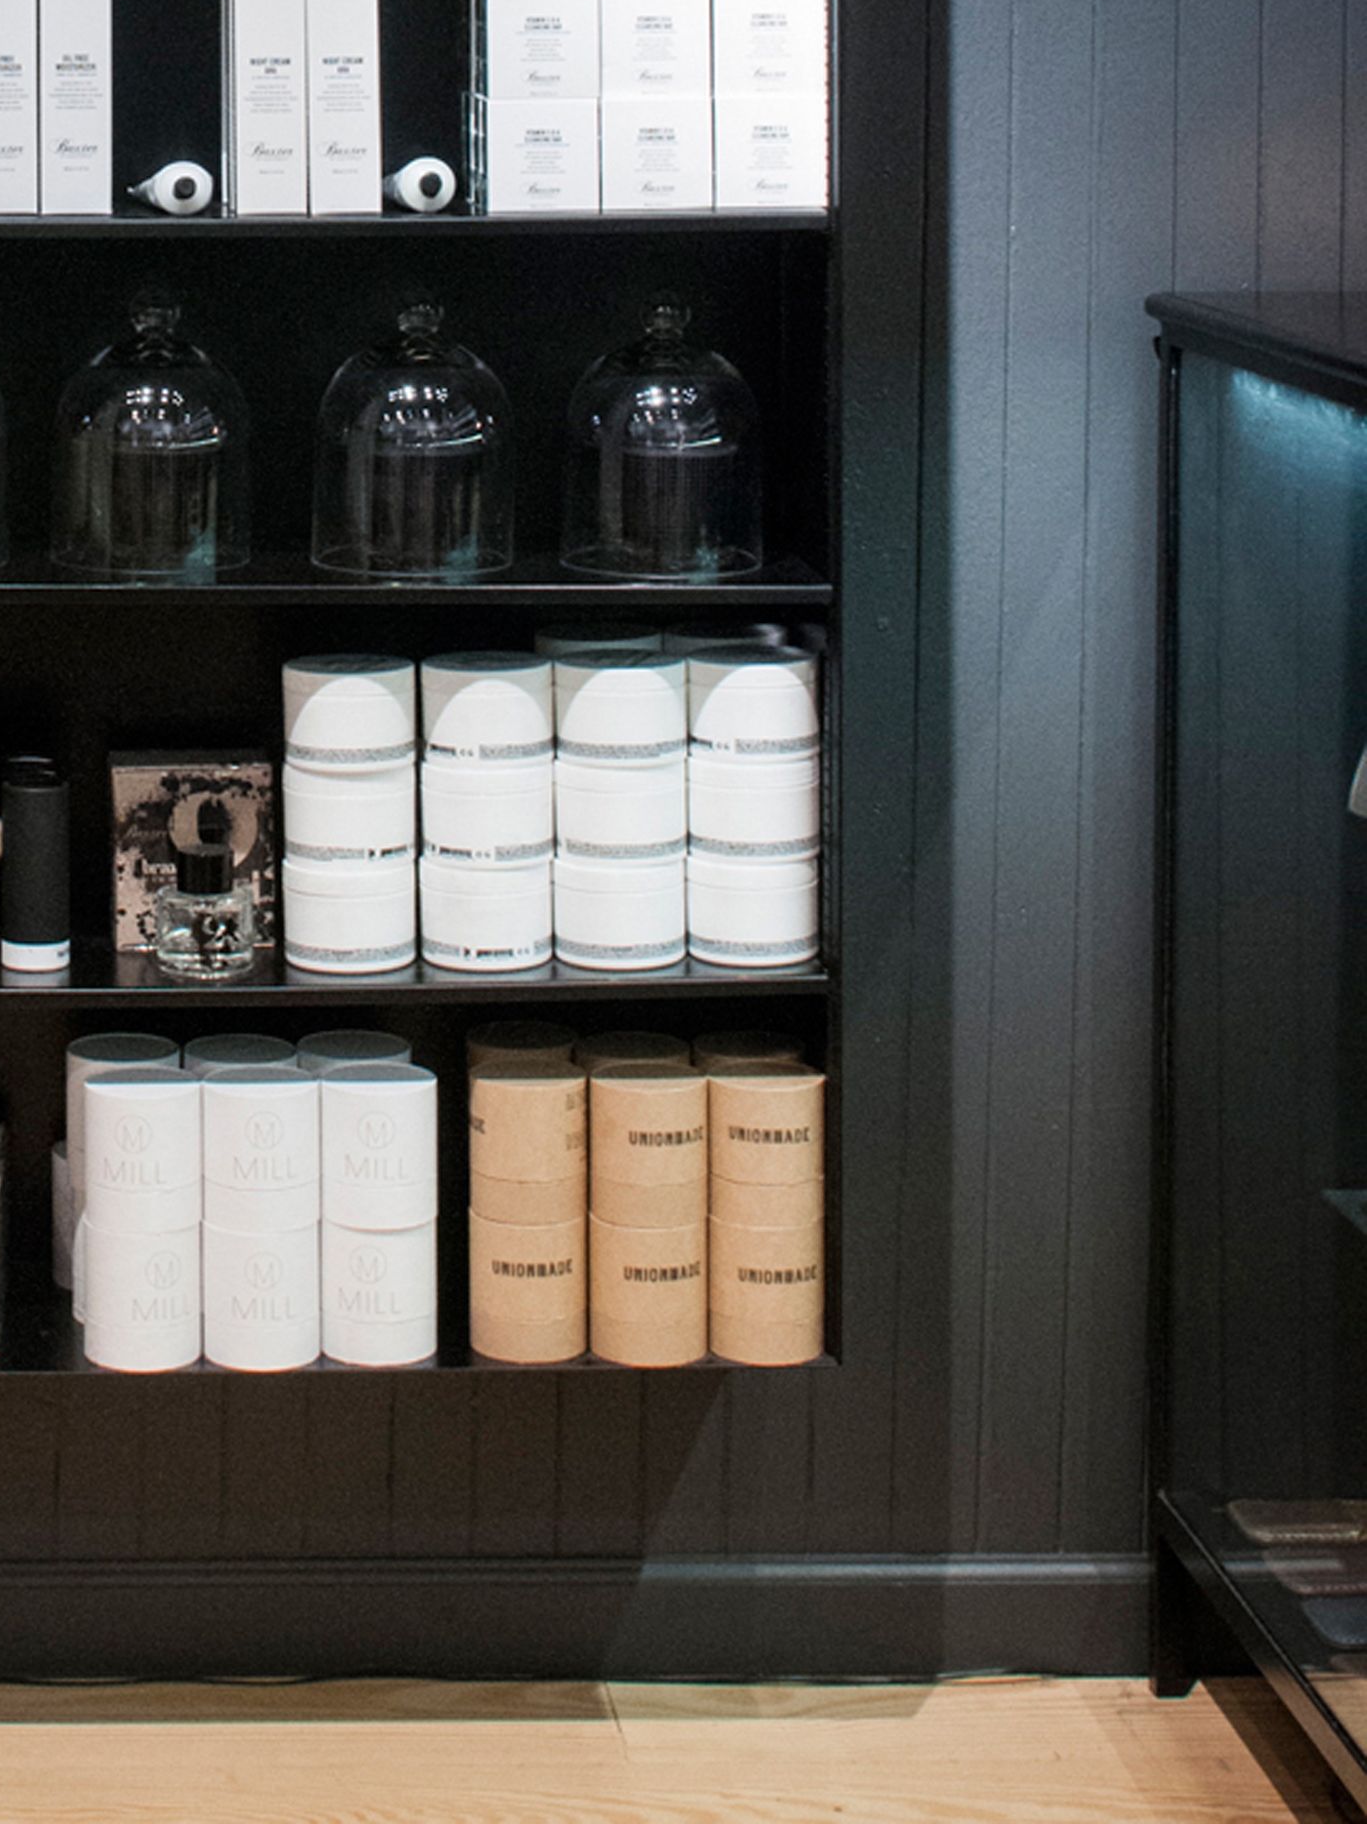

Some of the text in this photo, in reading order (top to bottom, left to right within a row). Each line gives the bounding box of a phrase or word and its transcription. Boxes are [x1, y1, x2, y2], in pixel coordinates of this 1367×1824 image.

[103, 1156, 167, 1185] MILL
[233, 1155, 296, 1180] MILL
[343, 1153, 409, 1181] MILL
[132, 1295, 190, 1322] MILL
[232, 1294, 296, 1321] MILL
[336, 1286, 402, 1315] MILL
